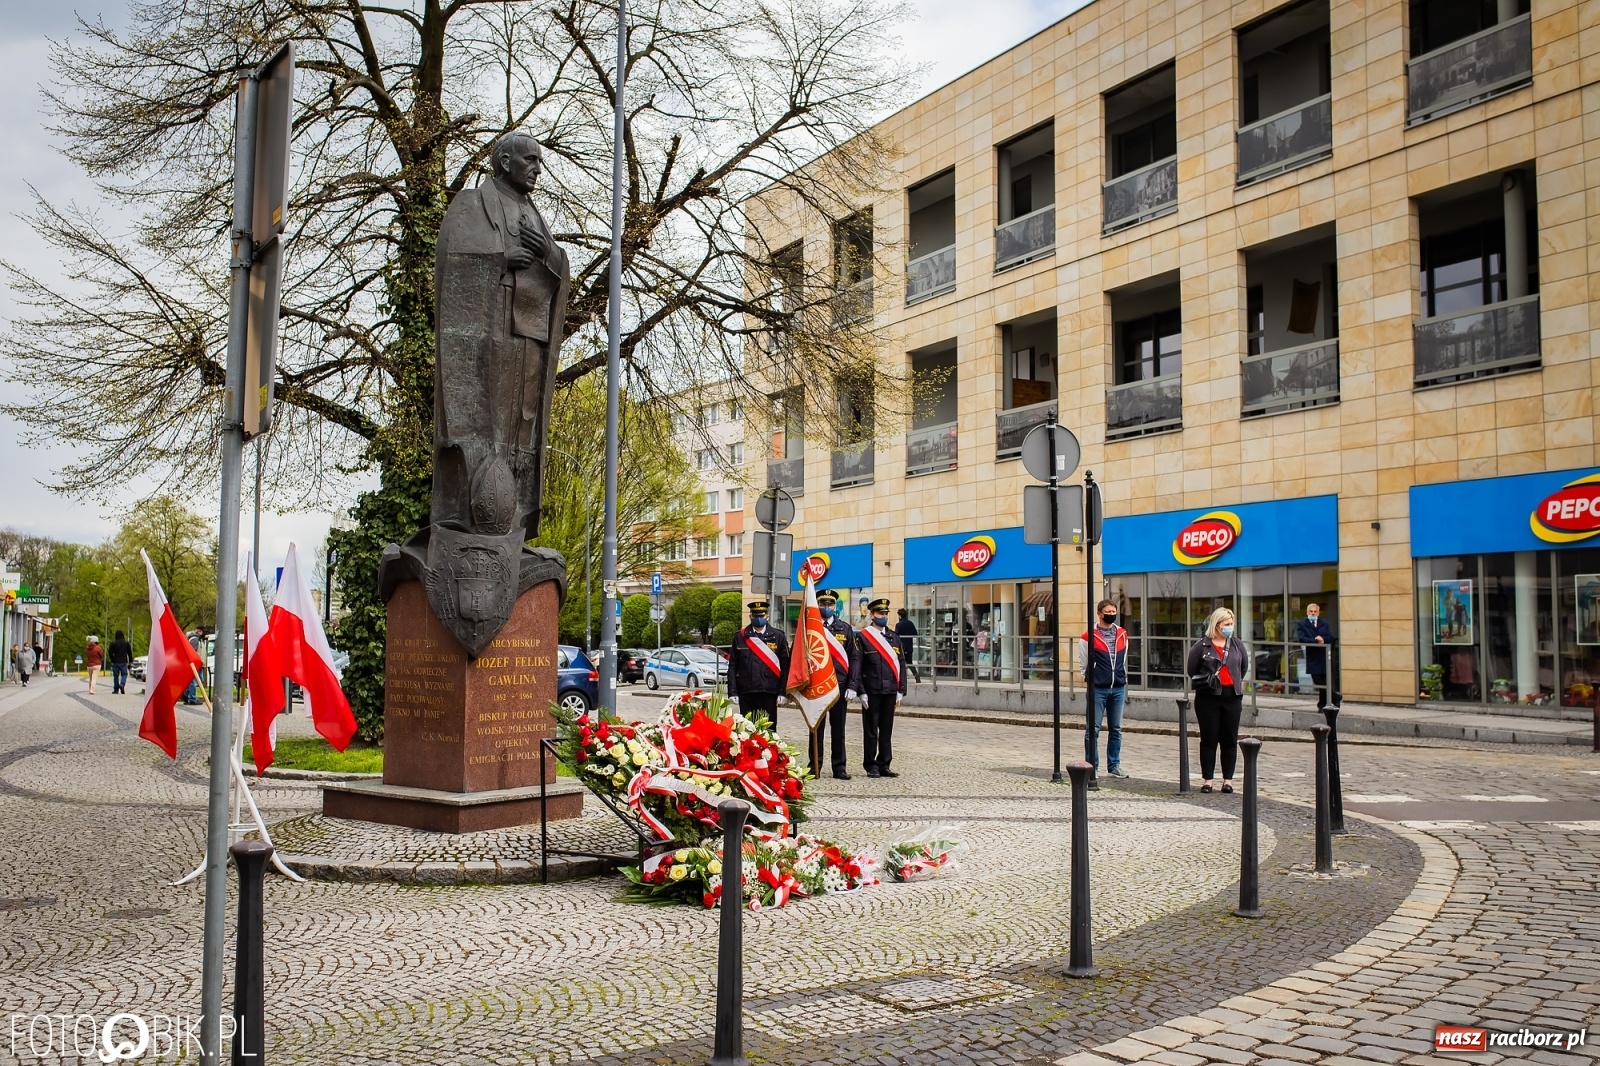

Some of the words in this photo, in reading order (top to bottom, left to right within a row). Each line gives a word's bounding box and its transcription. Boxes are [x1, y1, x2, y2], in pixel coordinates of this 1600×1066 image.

[1182, 528, 1228, 548] PEPCO
[958, 548, 986, 563] PEPCO
[654, 576, 659, 592] P
[490, 639, 540, 648] ARCYBISKUP
[516, 656, 550, 667] FELIKS
[489, 674, 536, 686] GAWLINA
[424, 682, 454, 691] WYZNANIE
[407, 694, 445, 704] POCHWALONY
[414, 709, 420, 717] MI
[479, 712, 507, 721] BISKUP
[512, 710, 545, 719] POLOWY
[477, 726, 504, 735] WOJSK
[509, 724, 546, 733] POLSKICH
[438, 733, 460, 742] Norwid
[495, 738, 530, 748] OPIEKUN
[470, 754, 513, 764] EMIGRACJI
